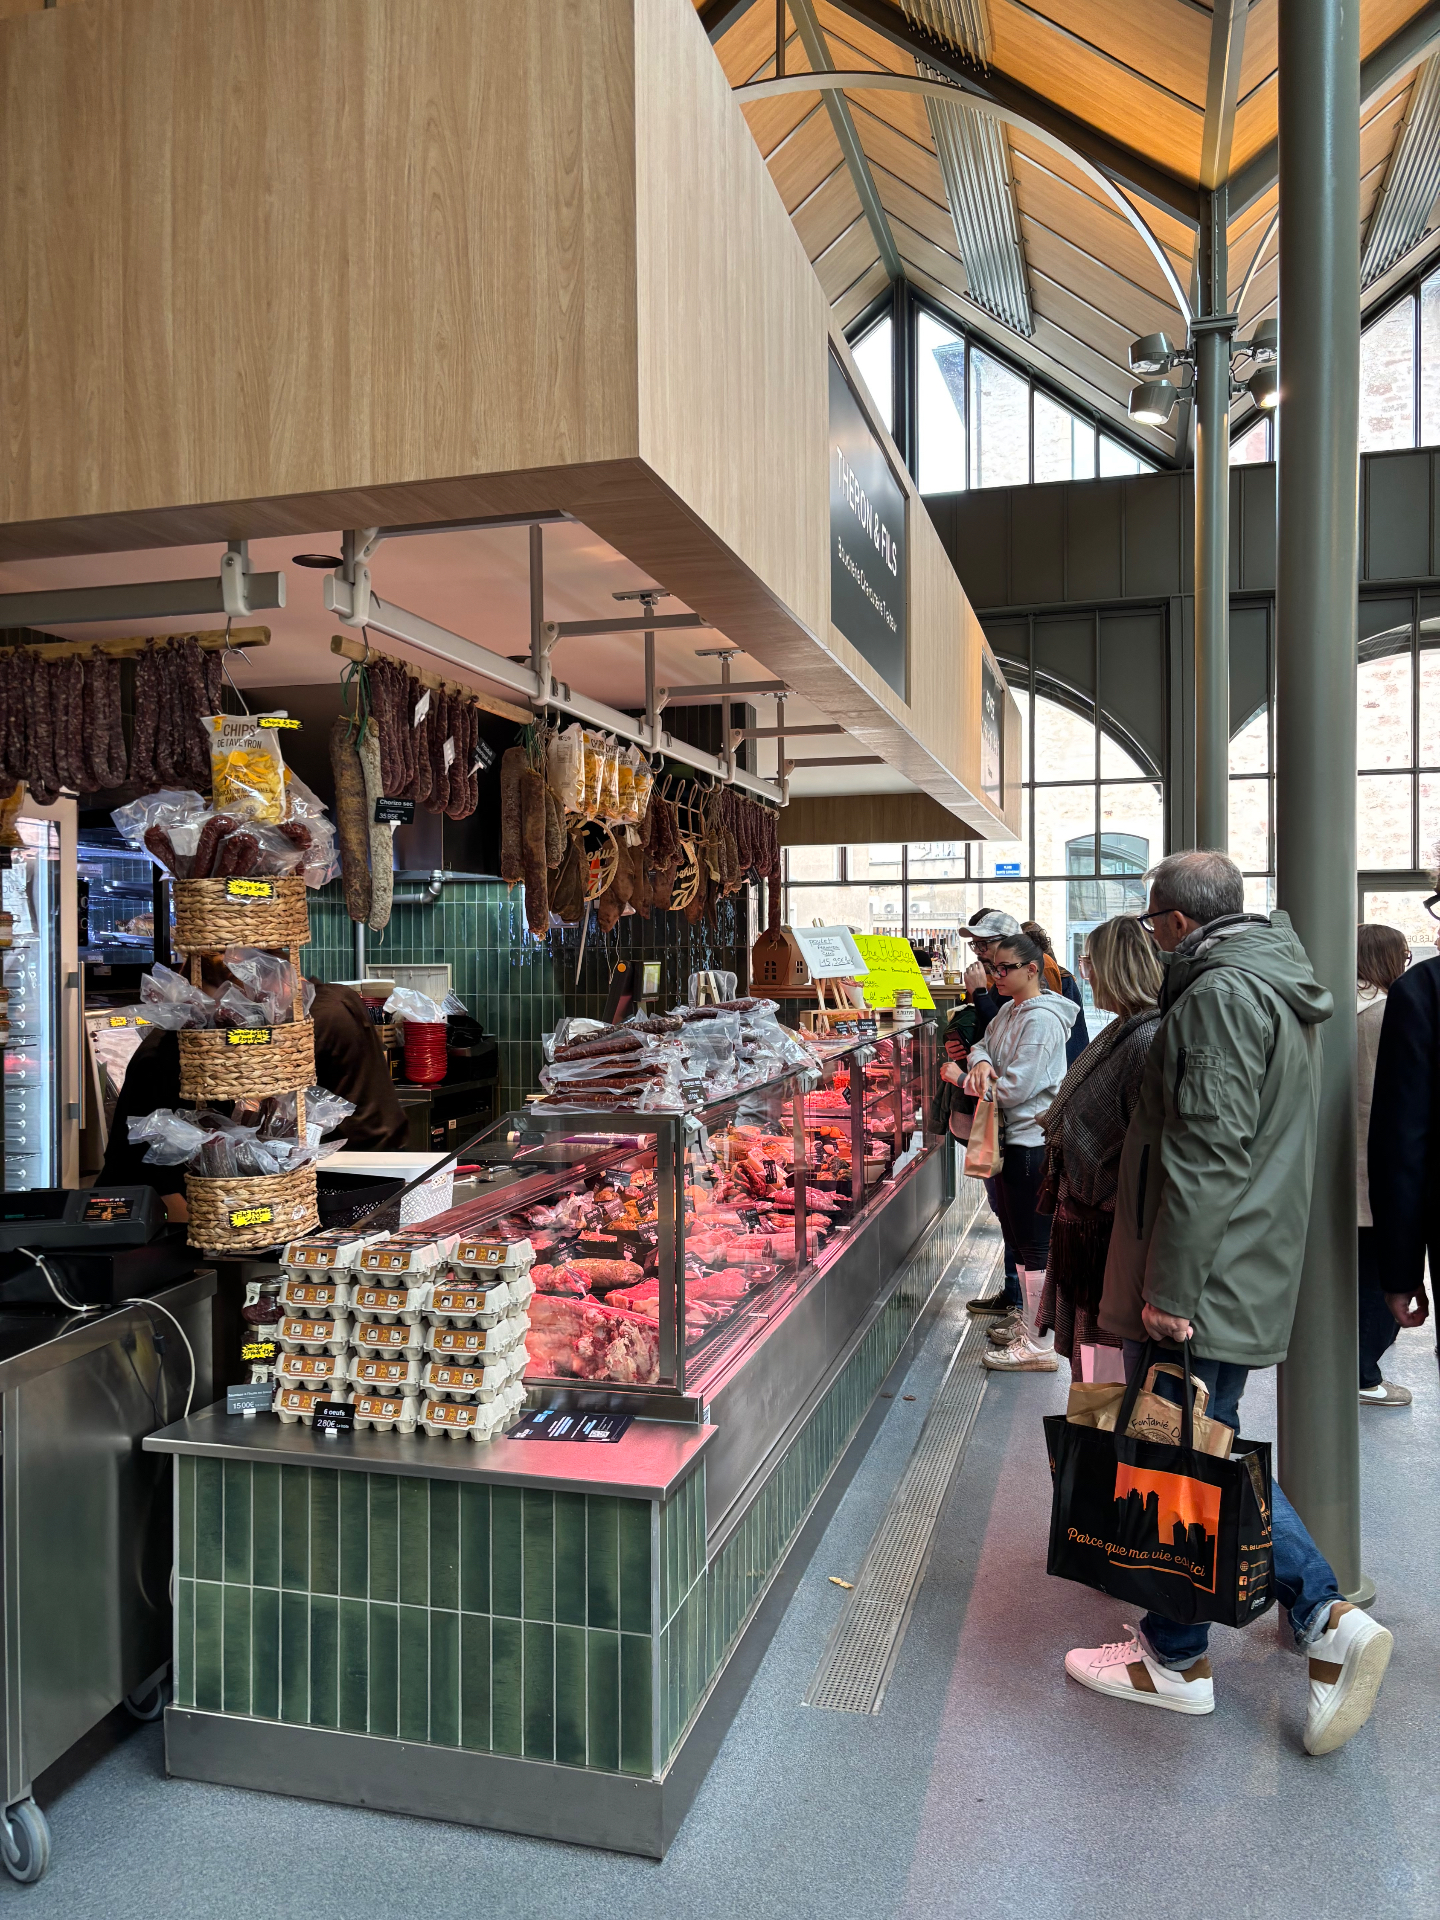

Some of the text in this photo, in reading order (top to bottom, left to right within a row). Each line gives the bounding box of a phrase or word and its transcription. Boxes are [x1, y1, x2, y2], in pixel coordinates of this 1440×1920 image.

[836, 444, 898, 577] THERON & FILS
[223, 723, 257, 738] CHIPS
[217, 739, 225, 748] DE
[1131, 1413, 1170, 1431] Fontanié
[1067, 1527, 1104, 1548] Parce
[1104, 1542, 1128, 1557] que
[1128, 1548, 1150, 1559] ma
[1151, 1549, 1173, 1562] vie
[1189, 1561, 1206, 1577] ici
